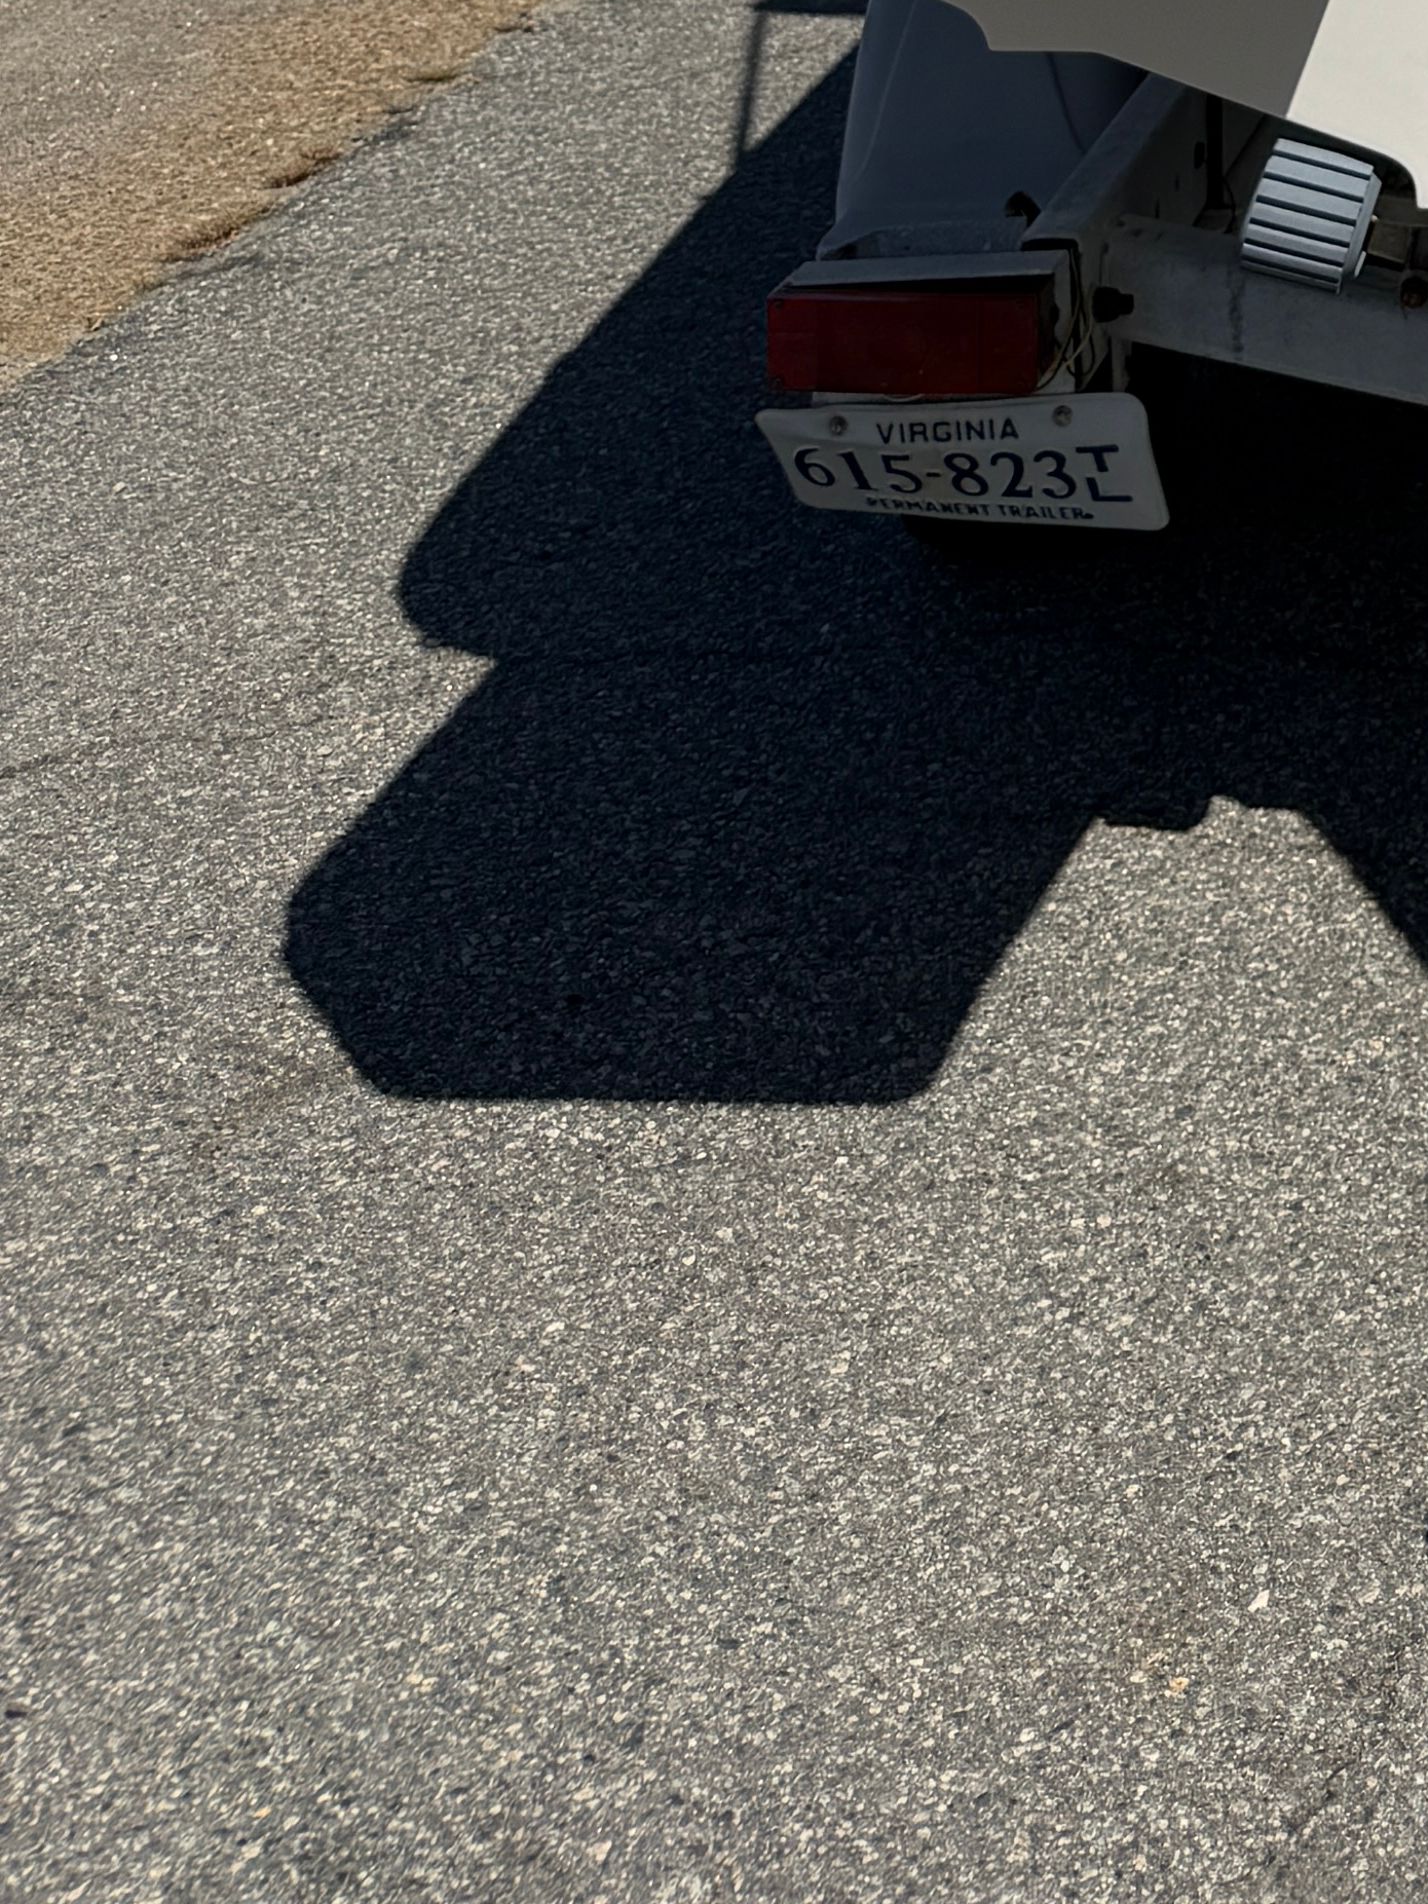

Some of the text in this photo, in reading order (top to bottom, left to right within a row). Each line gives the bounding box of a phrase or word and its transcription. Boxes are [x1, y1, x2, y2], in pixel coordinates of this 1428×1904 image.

[876, 418, 1020, 445] VIRGINIA
[866, 496, 1086, 521] PERMANENT TRAILER
